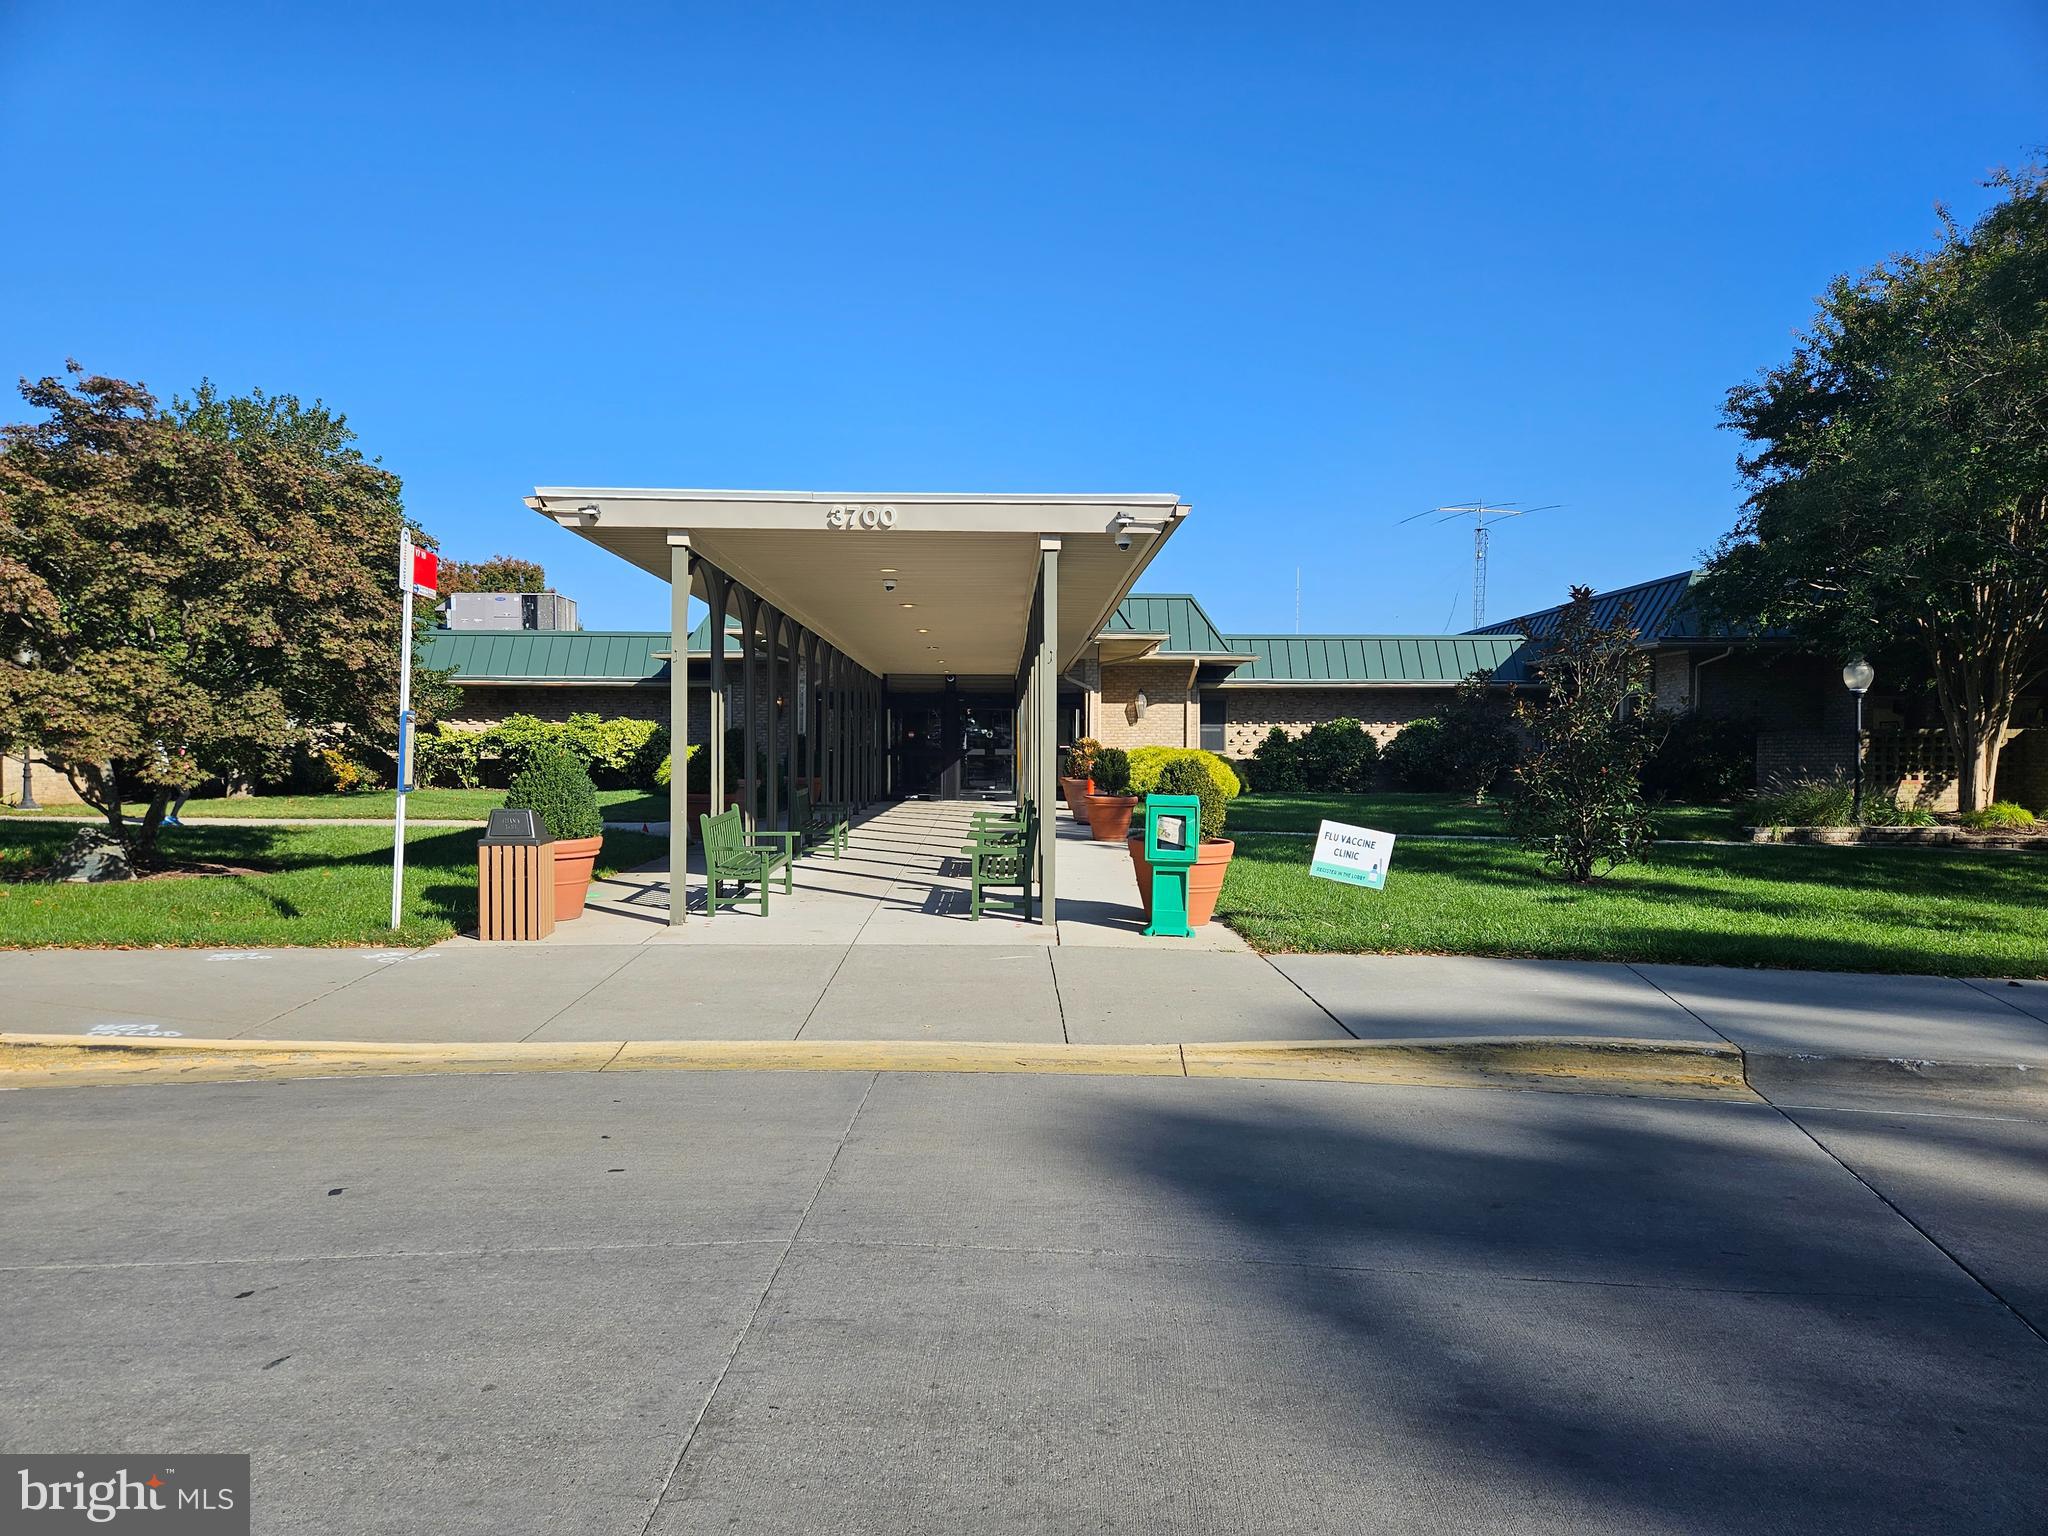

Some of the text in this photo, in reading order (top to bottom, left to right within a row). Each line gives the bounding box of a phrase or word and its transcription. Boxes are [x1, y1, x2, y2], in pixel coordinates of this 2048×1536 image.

[829, 505, 897, 527] 3700
[1324, 831, 1377, 850] FLU VACCINE
[1333, 848, 1360, 860] CLINIC
[1316, 866, 1337, 875] REGISTER
[1351, 873, 1366, 881] LOBBY
